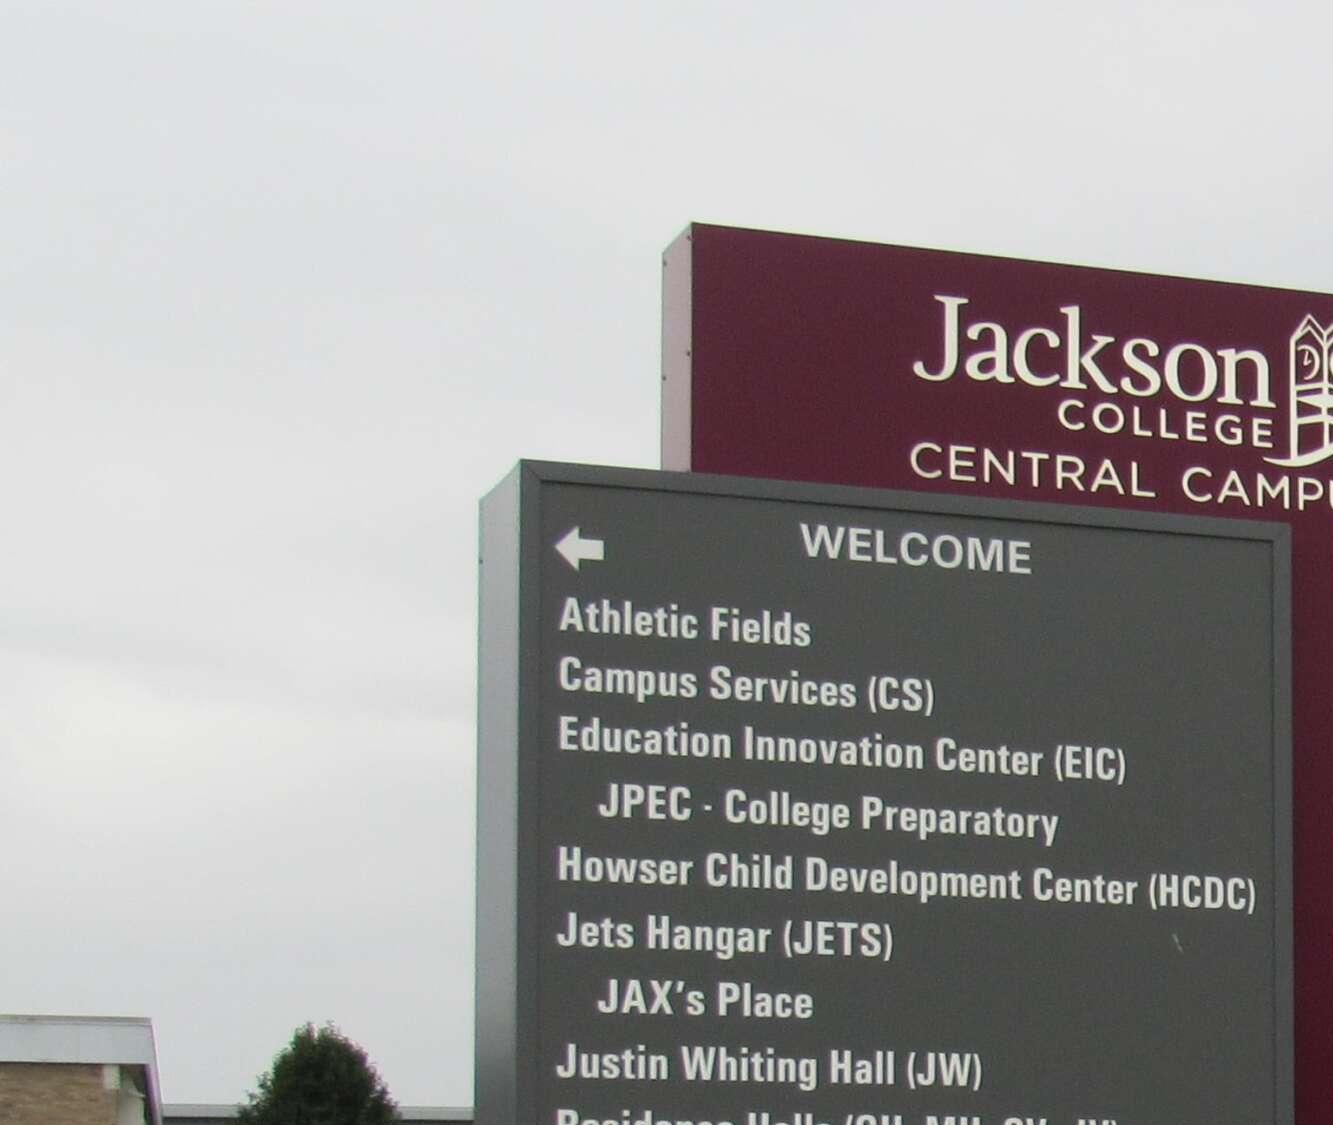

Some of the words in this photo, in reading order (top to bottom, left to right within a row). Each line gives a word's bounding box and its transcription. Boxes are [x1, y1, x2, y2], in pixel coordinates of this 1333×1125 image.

[911, 293, 1278, 410] Jackson
[1056, 398, 1274, 449] COLLEGE
[909, 441, 1157, 499] CENTRAL
[798, 522, 1032, 575] WELCOME
[558, 596, 699, 640] Athletic
[710, 606, 812, 648] Fields
[558, 655, 699, 704] Campus
[708, 664, 858, 709] Services
[867, 674, 935, 718] (CS)
[558, 714, 732, 760] Education
[743, 725, 925, 771] Innovation
[935, 736, 1045, 777] Center
[1053, 743, 1127, 786] (EIC)
[597, 782, 693, 822] JPEC
[724, 787, 851, 837] College
[861, 794, 1060, 848] Preparatory
[557, 845, 695, 887] Howser
[705, 851, 794, 891] Child
[804, 855, 1023, 905] Development
[1032, 866, 1139, 906] Center
[1148, 872, 1257, 916] (HCDC)
[555, 910, 635, 950] Jets
[646, 913, 773, 961] Hangar
[782, 918, 894, 963] (JETS)
[596, 977, 706, 1017] JAX's
[717, 981, 814, 1020] Place
[555, 1042, 669, 1081] Justin
[680, 1044, 818, 1093] Whiting
[829, 1048, 896, 1086] Hall
[906, 1050, 983, 1092] (JW)
